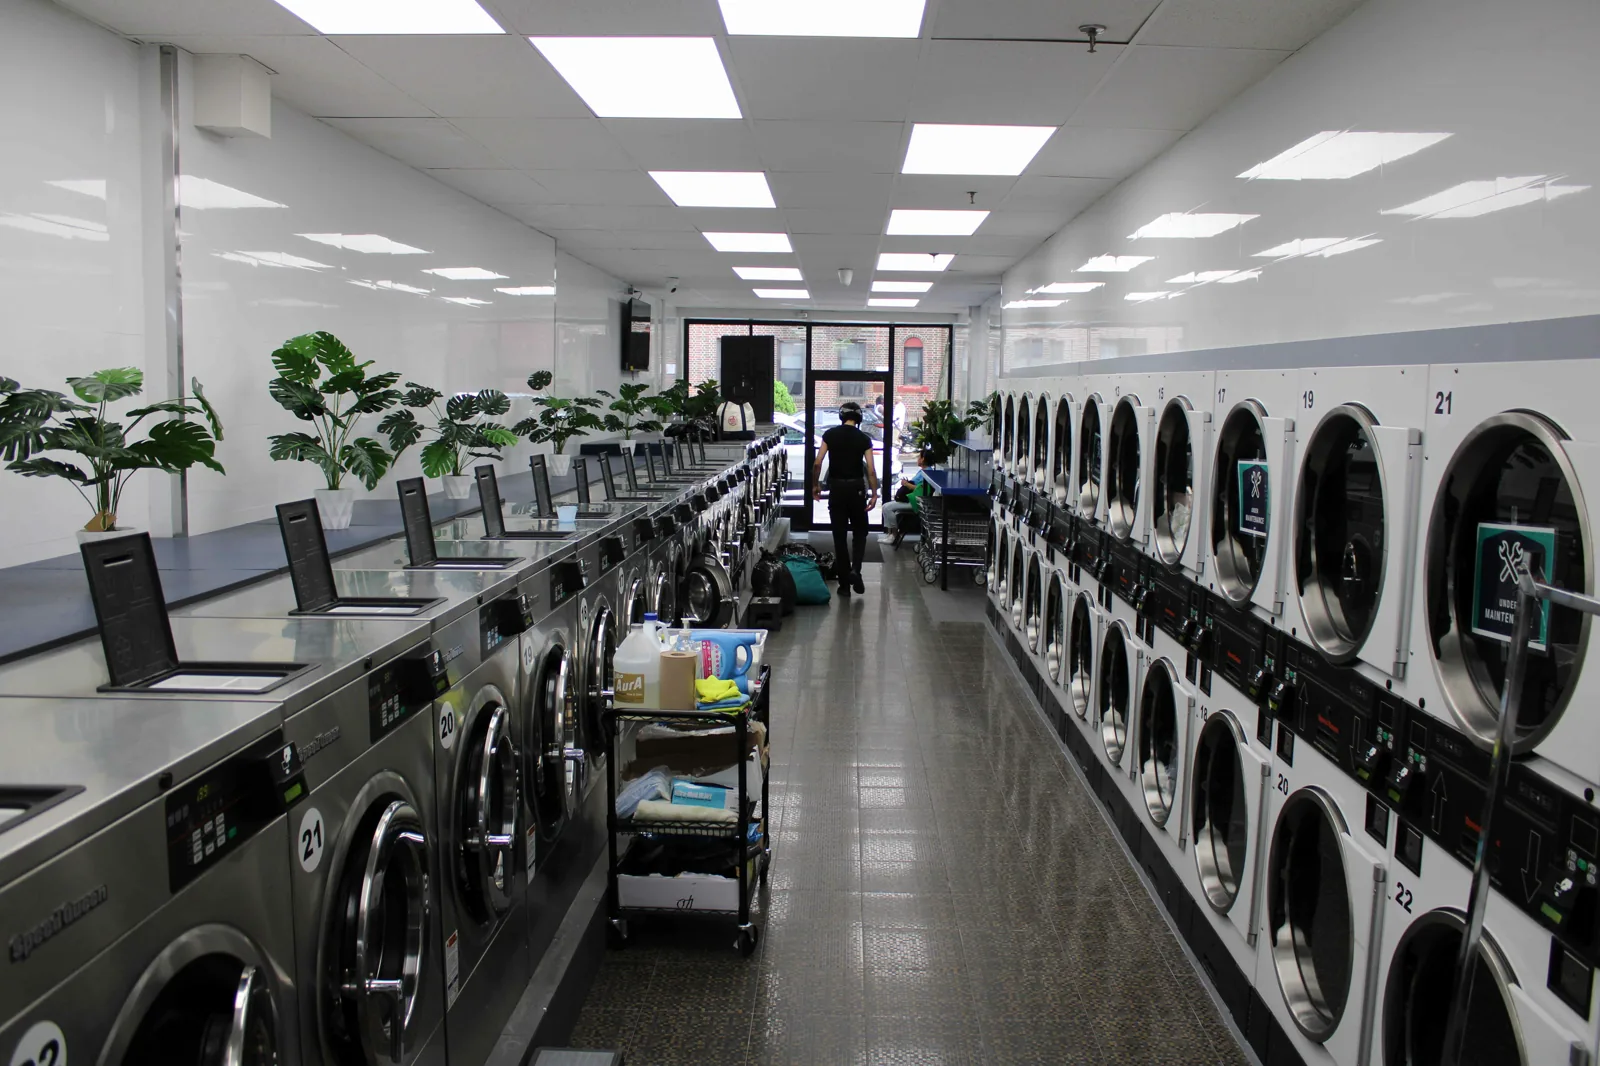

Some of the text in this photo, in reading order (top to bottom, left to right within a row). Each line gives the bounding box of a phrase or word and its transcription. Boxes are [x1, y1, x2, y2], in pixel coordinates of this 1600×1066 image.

[1217, 388, 1226, 404] 17
[1302, 390, 1314, 409] 19
[1434, 391, 1452, 415] 21
[523, 645, 533, 666] 19
[1200, 705, 1208, 722] 18
[440, 711, 454, 740] 20
[1277, 773, 1289, 796] 20
[302, 820, 322, 862] 21
[1395, 881, 1413, 914] 22
